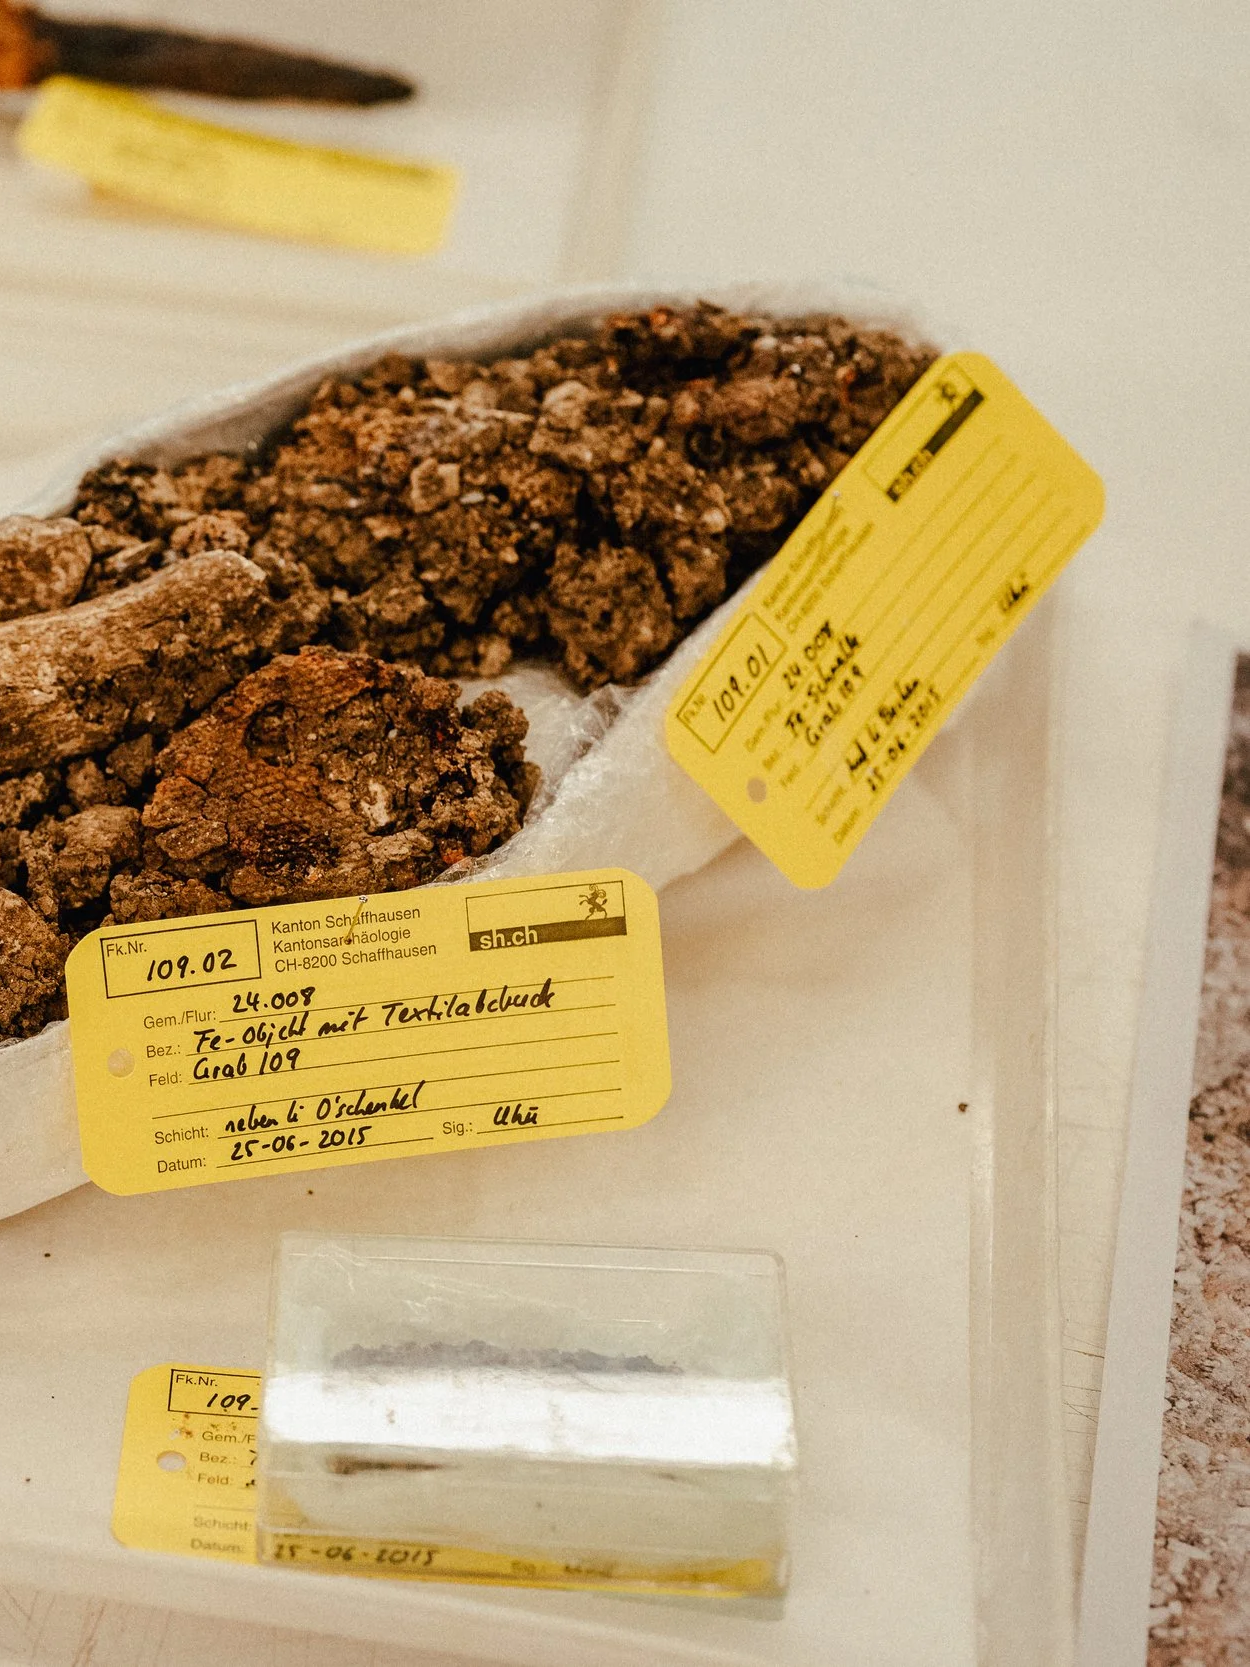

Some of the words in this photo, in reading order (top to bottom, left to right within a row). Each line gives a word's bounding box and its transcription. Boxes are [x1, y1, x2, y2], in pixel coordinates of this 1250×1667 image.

[713, 643, 778, 722] 109.01
[272, 920, 321, 934] Kanton
[326, 909, 420, 928] Schaffhausen
[106, 941, 147, 957] Fk.Nr.
[273, 927, 410, 954] Kantonsarchäologie
[477, 923, 541, 953] sh.ch
[147, 949, 237, 981] 109.02
[275, 954, 337, 973] CH-8200
[342, 945, 436, 965] Schaffhausen
[233, 986, 316, 1013] 24.008
[144, 1010, 220, 1029] Gem./Flur:
[318, 1006, 368, 1037] mit
[146, 1045, 180, 1058] Bez.:
[193, 1053, 250, 1083] Grab
[259, 1048, 304, 1075] 109
[149, 1071, 182, 1087] Feld:
[225, 1104, 279, 1133] neben
[443, 1121, 472, 1136] Sig.:
[155, 1126, 209, 1144] Schicht:
[231, 1126, 373, 1161] 25-06-2015
[158, 1158, 206, 1173] Datum:
[176, 1375, 218, 1386] Fk.Nr.
[202, 1431, 255, 1443] Gem./F
